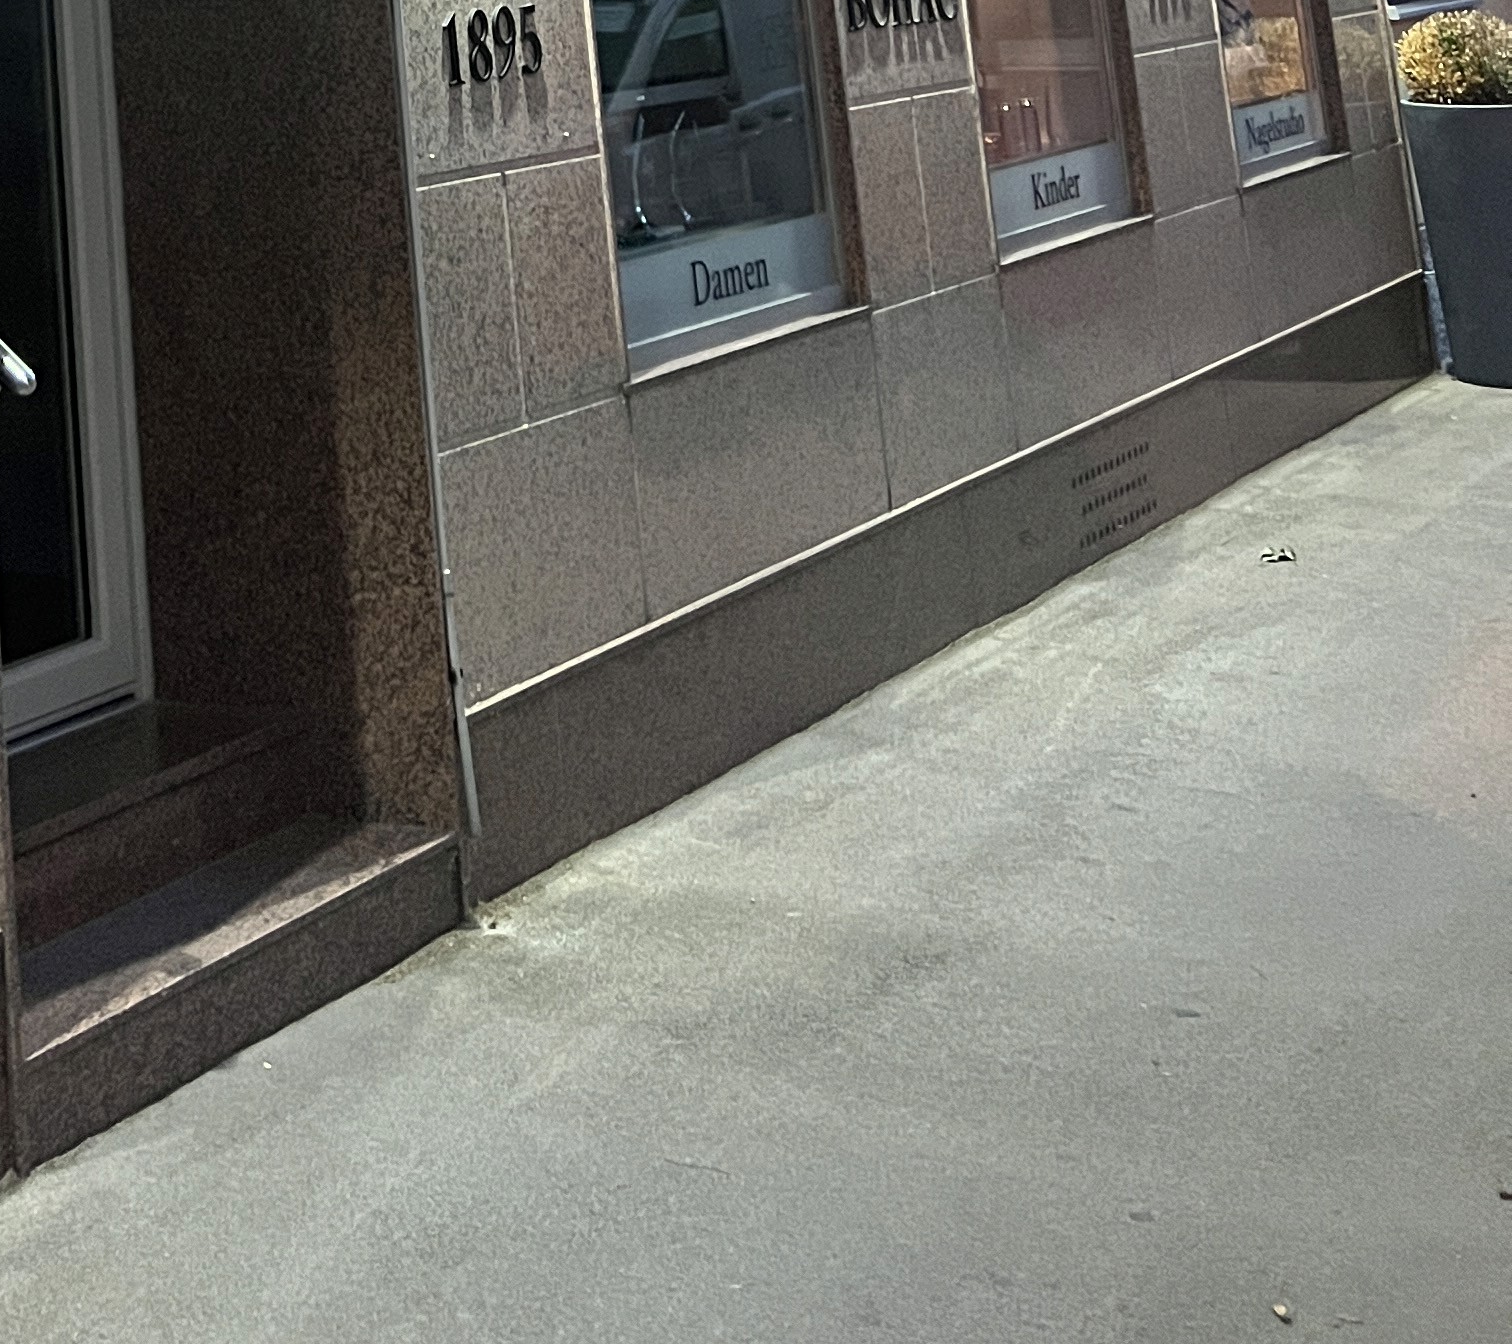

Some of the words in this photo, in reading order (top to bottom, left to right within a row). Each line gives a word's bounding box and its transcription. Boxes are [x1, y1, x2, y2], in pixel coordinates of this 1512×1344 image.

[441, 3, 544, 87] 1895
[1030, 165, 1080, 210] Kinder
[690, 256, 770, 307] Damen
